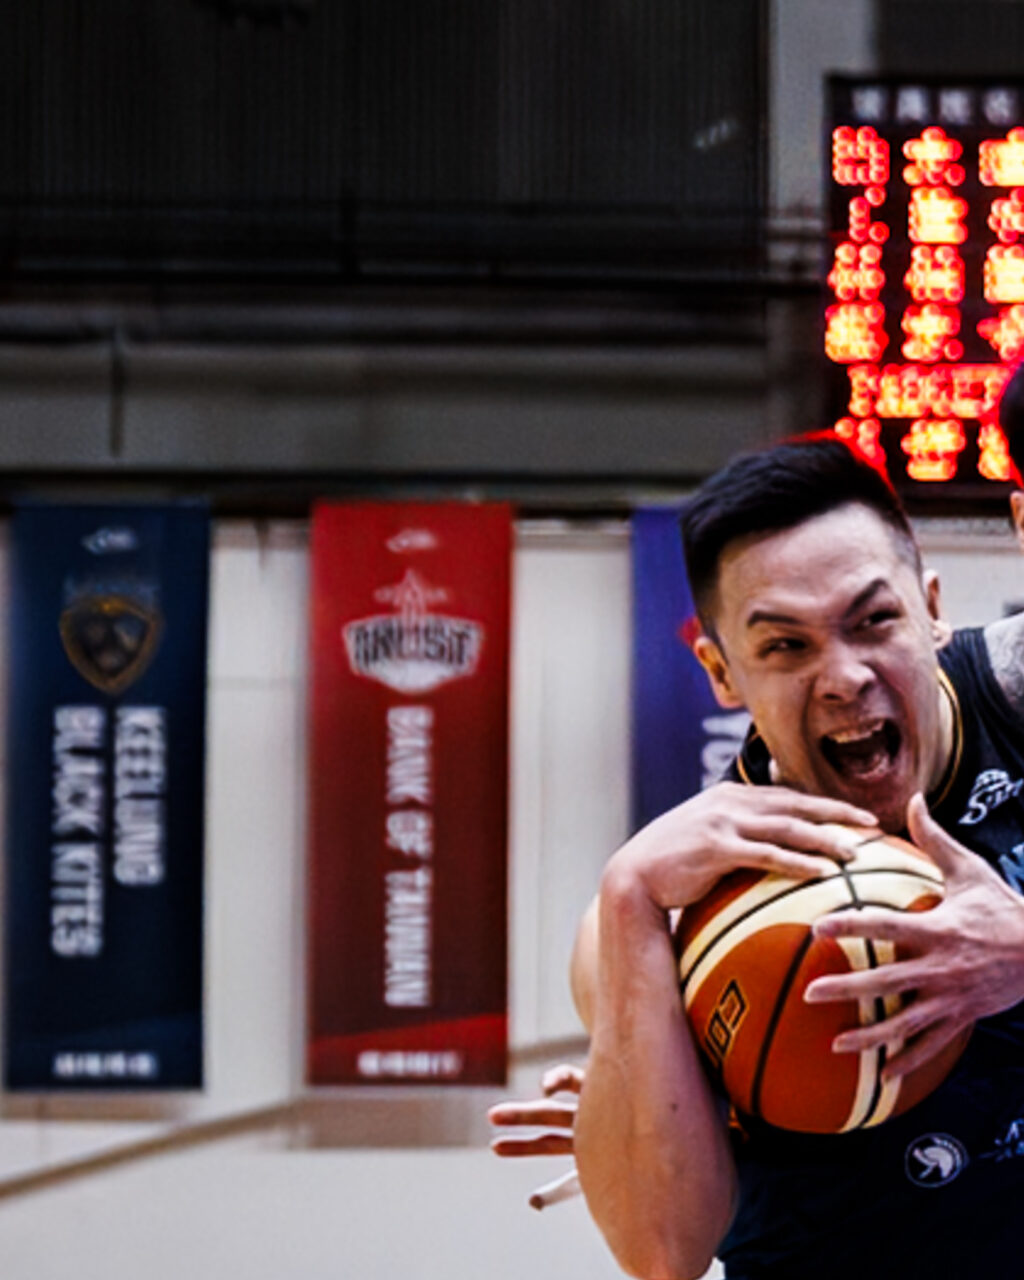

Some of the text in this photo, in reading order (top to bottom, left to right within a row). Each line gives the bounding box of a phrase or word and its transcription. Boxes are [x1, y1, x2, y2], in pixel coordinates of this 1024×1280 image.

[114, 705, 165, 885] KEELUNG
[386, 704, 433, 803] BANK
[51, 705, 105, 957] BLACK KITES
[386, 809, 432, 858] OF
[384, 864, 431, 1007] TAIWAN
